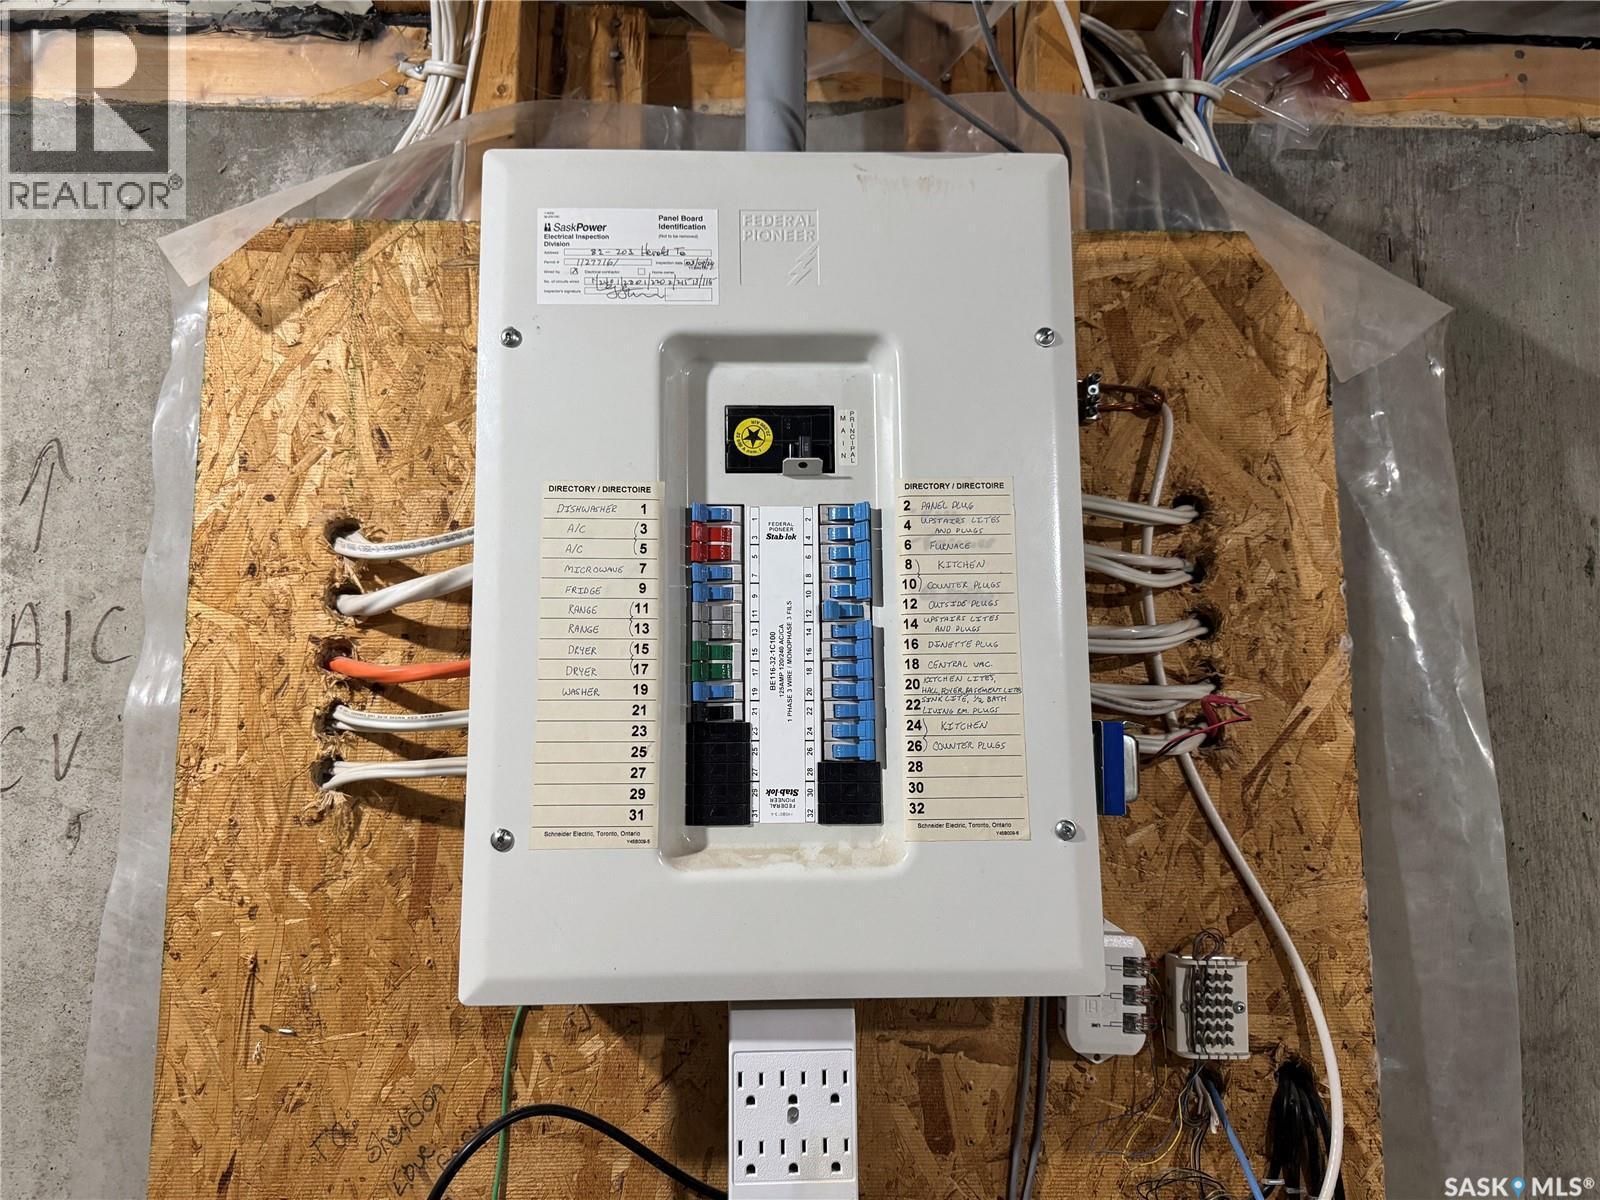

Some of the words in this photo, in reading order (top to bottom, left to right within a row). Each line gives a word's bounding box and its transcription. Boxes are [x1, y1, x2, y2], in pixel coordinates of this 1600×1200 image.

[743, 214, 816, 228] FEDERAL
[554, 222, 607, 232] SaskPower
[743, 229, 816, 242] PIONEER
[557, 504, 618, 513] DISHWASHER
[641, 504, 647, 514] 1
[903, 500, 911, 511] 2
[920, 502, 948, 510] PANEL
[952, 501, 974, 510] PLUG
[567, 523, 586, 533] A/C
[640, 524, 648, 534] 3
[903, 520, 911, 530] 4
[565, 544, 583, 553] A/C
[640, 544, 647, 554] 5
[904, 540, 912, 550] 6
[930, 541, 971, 550] FURNACE
[564, 565, 624, 574] MICROWAVE
[639, 563, 647, 573] 7
[904, 559, 912, 570] 8
[937, 560, 985, 569] KITCHEN
[639, 583, 646, 593] 9
[902, 579, 917, 589] 10
[927, 580, 968, 590] COUNTER
[974, 580, 1001, 589] PLUGS
[565, 586, 602, 595] FRIDGE
[568, 604, 598, 614] RANGE
[634, 603, 649, 613] 11
[902, 599, 918, 609] 12
[928, 600, 967, 609] OUTSIDE
[971, 600, 999, 608] PLUGS
[806, 609, 812, 617] 12
[903, 619, 918, 629] 14
[923, 615, 966, 623] UPSTAIRS
[568, 624, 599, 634] RANGE
[634, 623, 650, 634] 13
[634, 644, 649, 654] 15
[904, 639, 919, 649] 16
[928, 640, 972, 648] DINETTE
[568, 645, 598, 655] DRYER
[806, 648, 812, 656] 16
[633, 664, 648, 674] 17
[904, 659, 920, 670] 18
[928, 661, 968, 670] CENTRAL
[566, 666, 597, 677] DRYER
[632, 684, 648, 695] 19
[905, 679, 920, 690] 20
[562, 688, 600, 697] WASHER
[806, 688, 812, 696] 20
[905, 699, 921, 710] 22
[632, 705, 646, 716] 21
[752, 707, 758, 715] 21
[806, 707, 813, 715] 22
[631, 725, 647, 736] 23
[906, 720, 922, 731] 24
[940, 721, 988, 731] KITCHEN
[752, 727, 758, 736] 23
[807, 727, 813, 735] 24
[907, 740, 923, 752] 26
[933, 741, 974, 751] COUNTER
[977, 741, 1006, 750] PLUGS
[631, 746, 647, 757] 25
[752, 747, 758, 756] 25
[807, 747, 813, 756] 26
[908, 761, 923, 772] 28
[630, 767, 646, 778] 27
[752, 768, 758, 776] 27
[807, 768, 813, 776] 28
[752, 788, 758, 797] 29
[807, 788, 814, 797] 30
[908, 782, 924, 793] 30
[629, 788, 646, 799] 29
[752, 809, 758, 817] 31
[807, 809, 813, 817] 32
[909, 803, 925, 814] 32
[629, 809, 644, 820] 31
